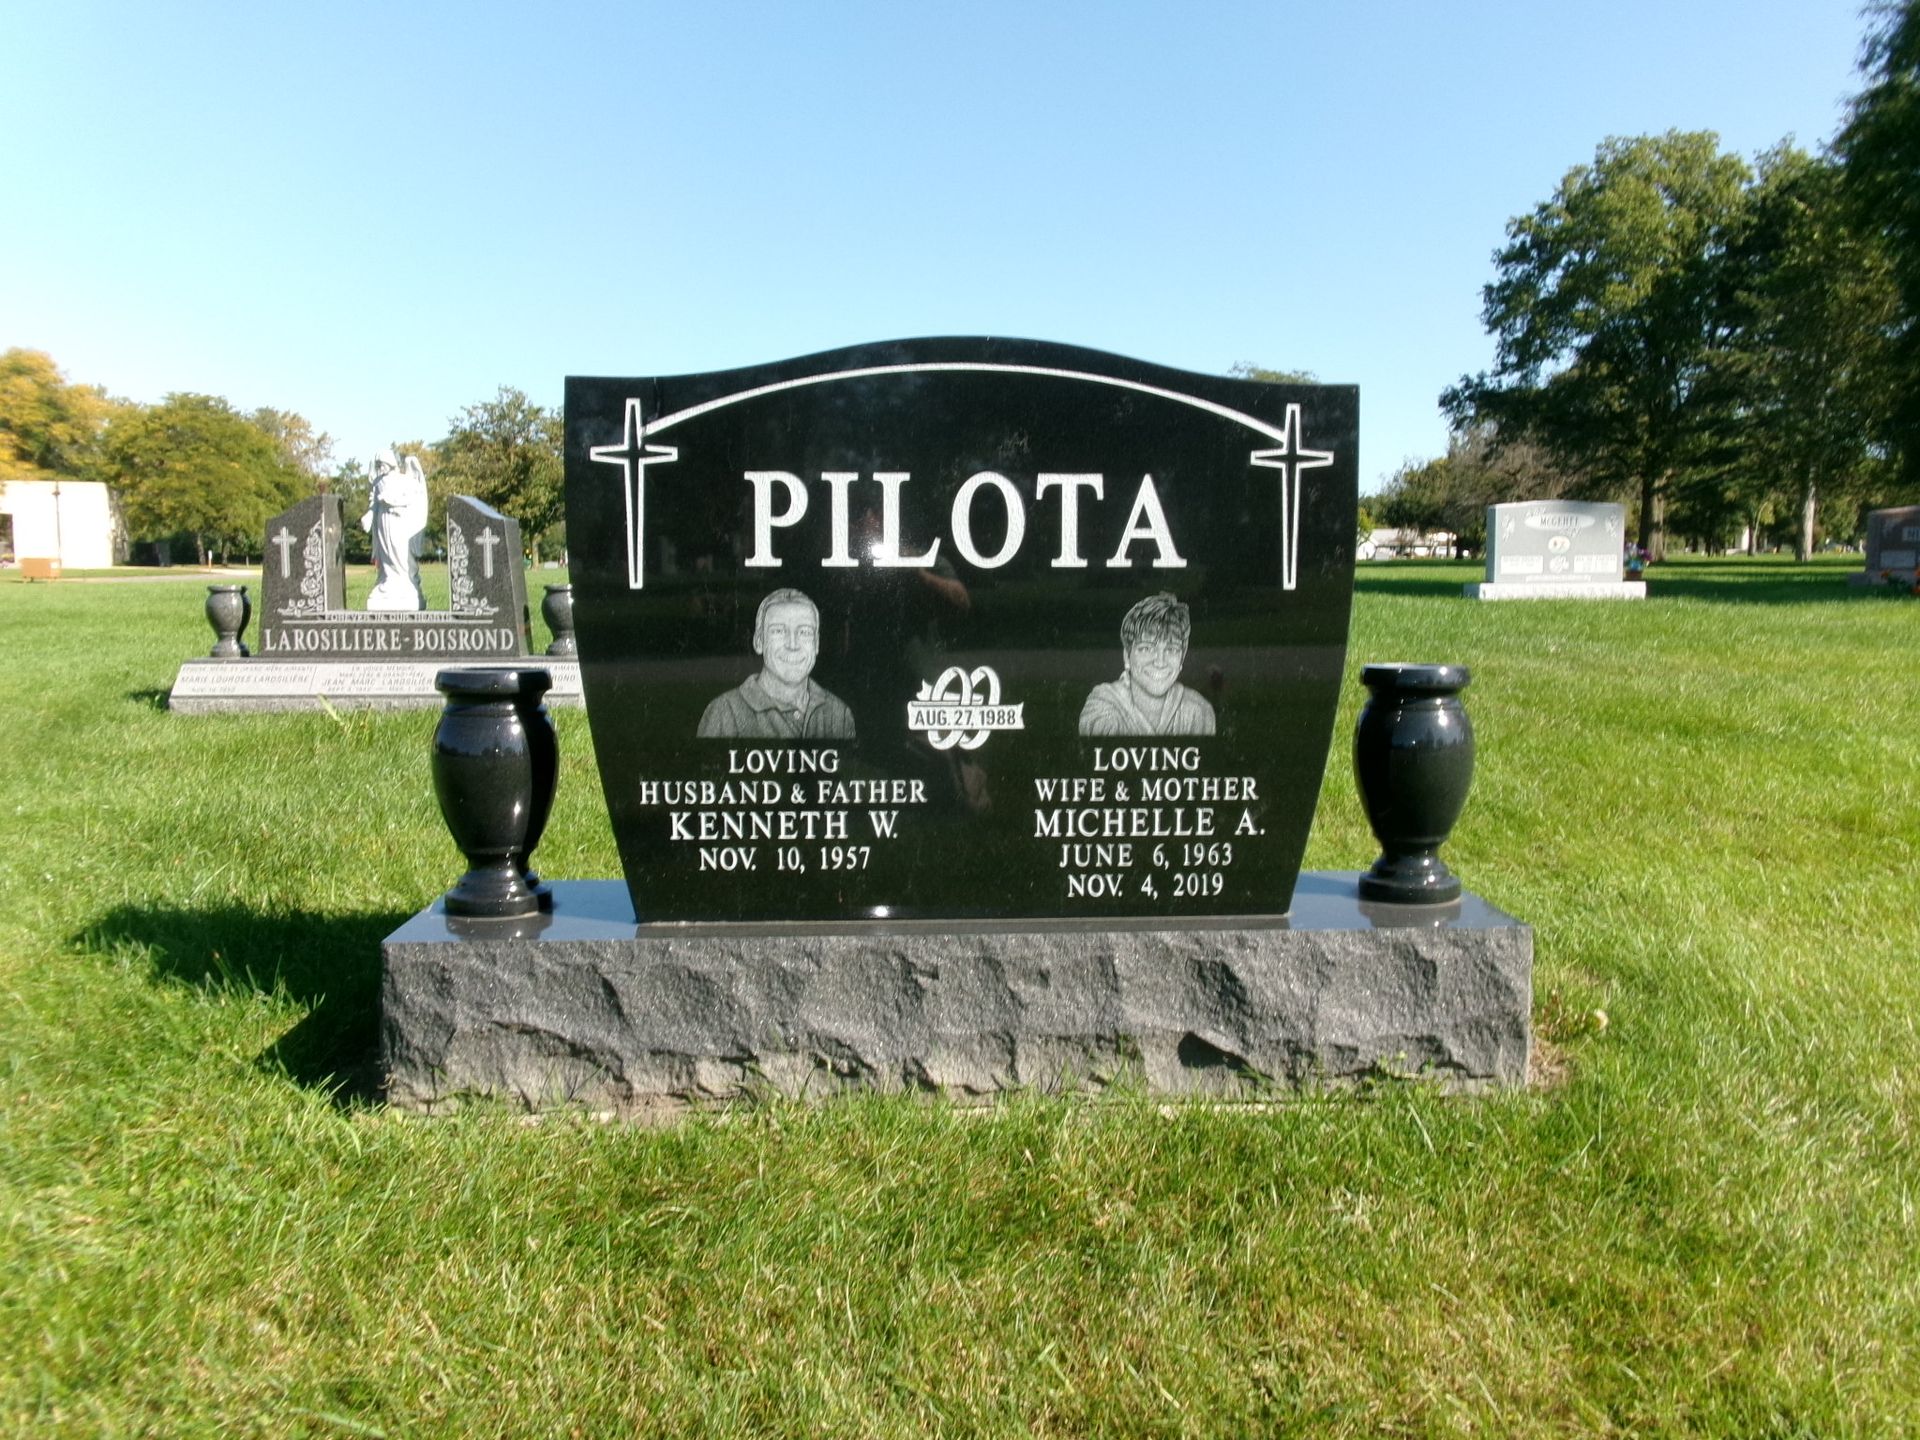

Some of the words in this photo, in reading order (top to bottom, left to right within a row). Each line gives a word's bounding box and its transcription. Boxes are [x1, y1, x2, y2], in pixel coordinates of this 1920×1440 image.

[744, 471, 1187, 568] PILOTA
[915, 709, 951, 726] AUG.
[954, 709, 974, 728] 27,
[980, 709, 1016, 726] 1988
[729, 749, 840, 773] LOVING
[1094, 747, 1201, 771] LOVING
[640, 781, 781, 804] HUSBAND
[791, 783, 806, 803] &
[818, 780, 927, 803] FATHER
[1034, 778, 1106, 802] WIFE
[1115, 781, 1130, 801] &
[1141, 777, 1259, 801] MOTHER
[670, 811, 849, 841] KENNETH
[868, 810, 898, 839] W.
[1034, 808, 1215, 837] MICHELLE
[1235, 808, 1266, 836] A.
[700, 847, 756, 871] NOV.
[777, 847, 805, 873] 10,
[820, 846, 870, 869] 1957
[1059, 844, 1133, 868] JUNE
[1153, 843, 1170, 870] 6,
[1183, 842, 1232, 867] 1963
[1068, 874, 1123, 897] NOV.
[1141, 874, 1158, 900] 4,
[1173, 872, 1223, 896] 2019
